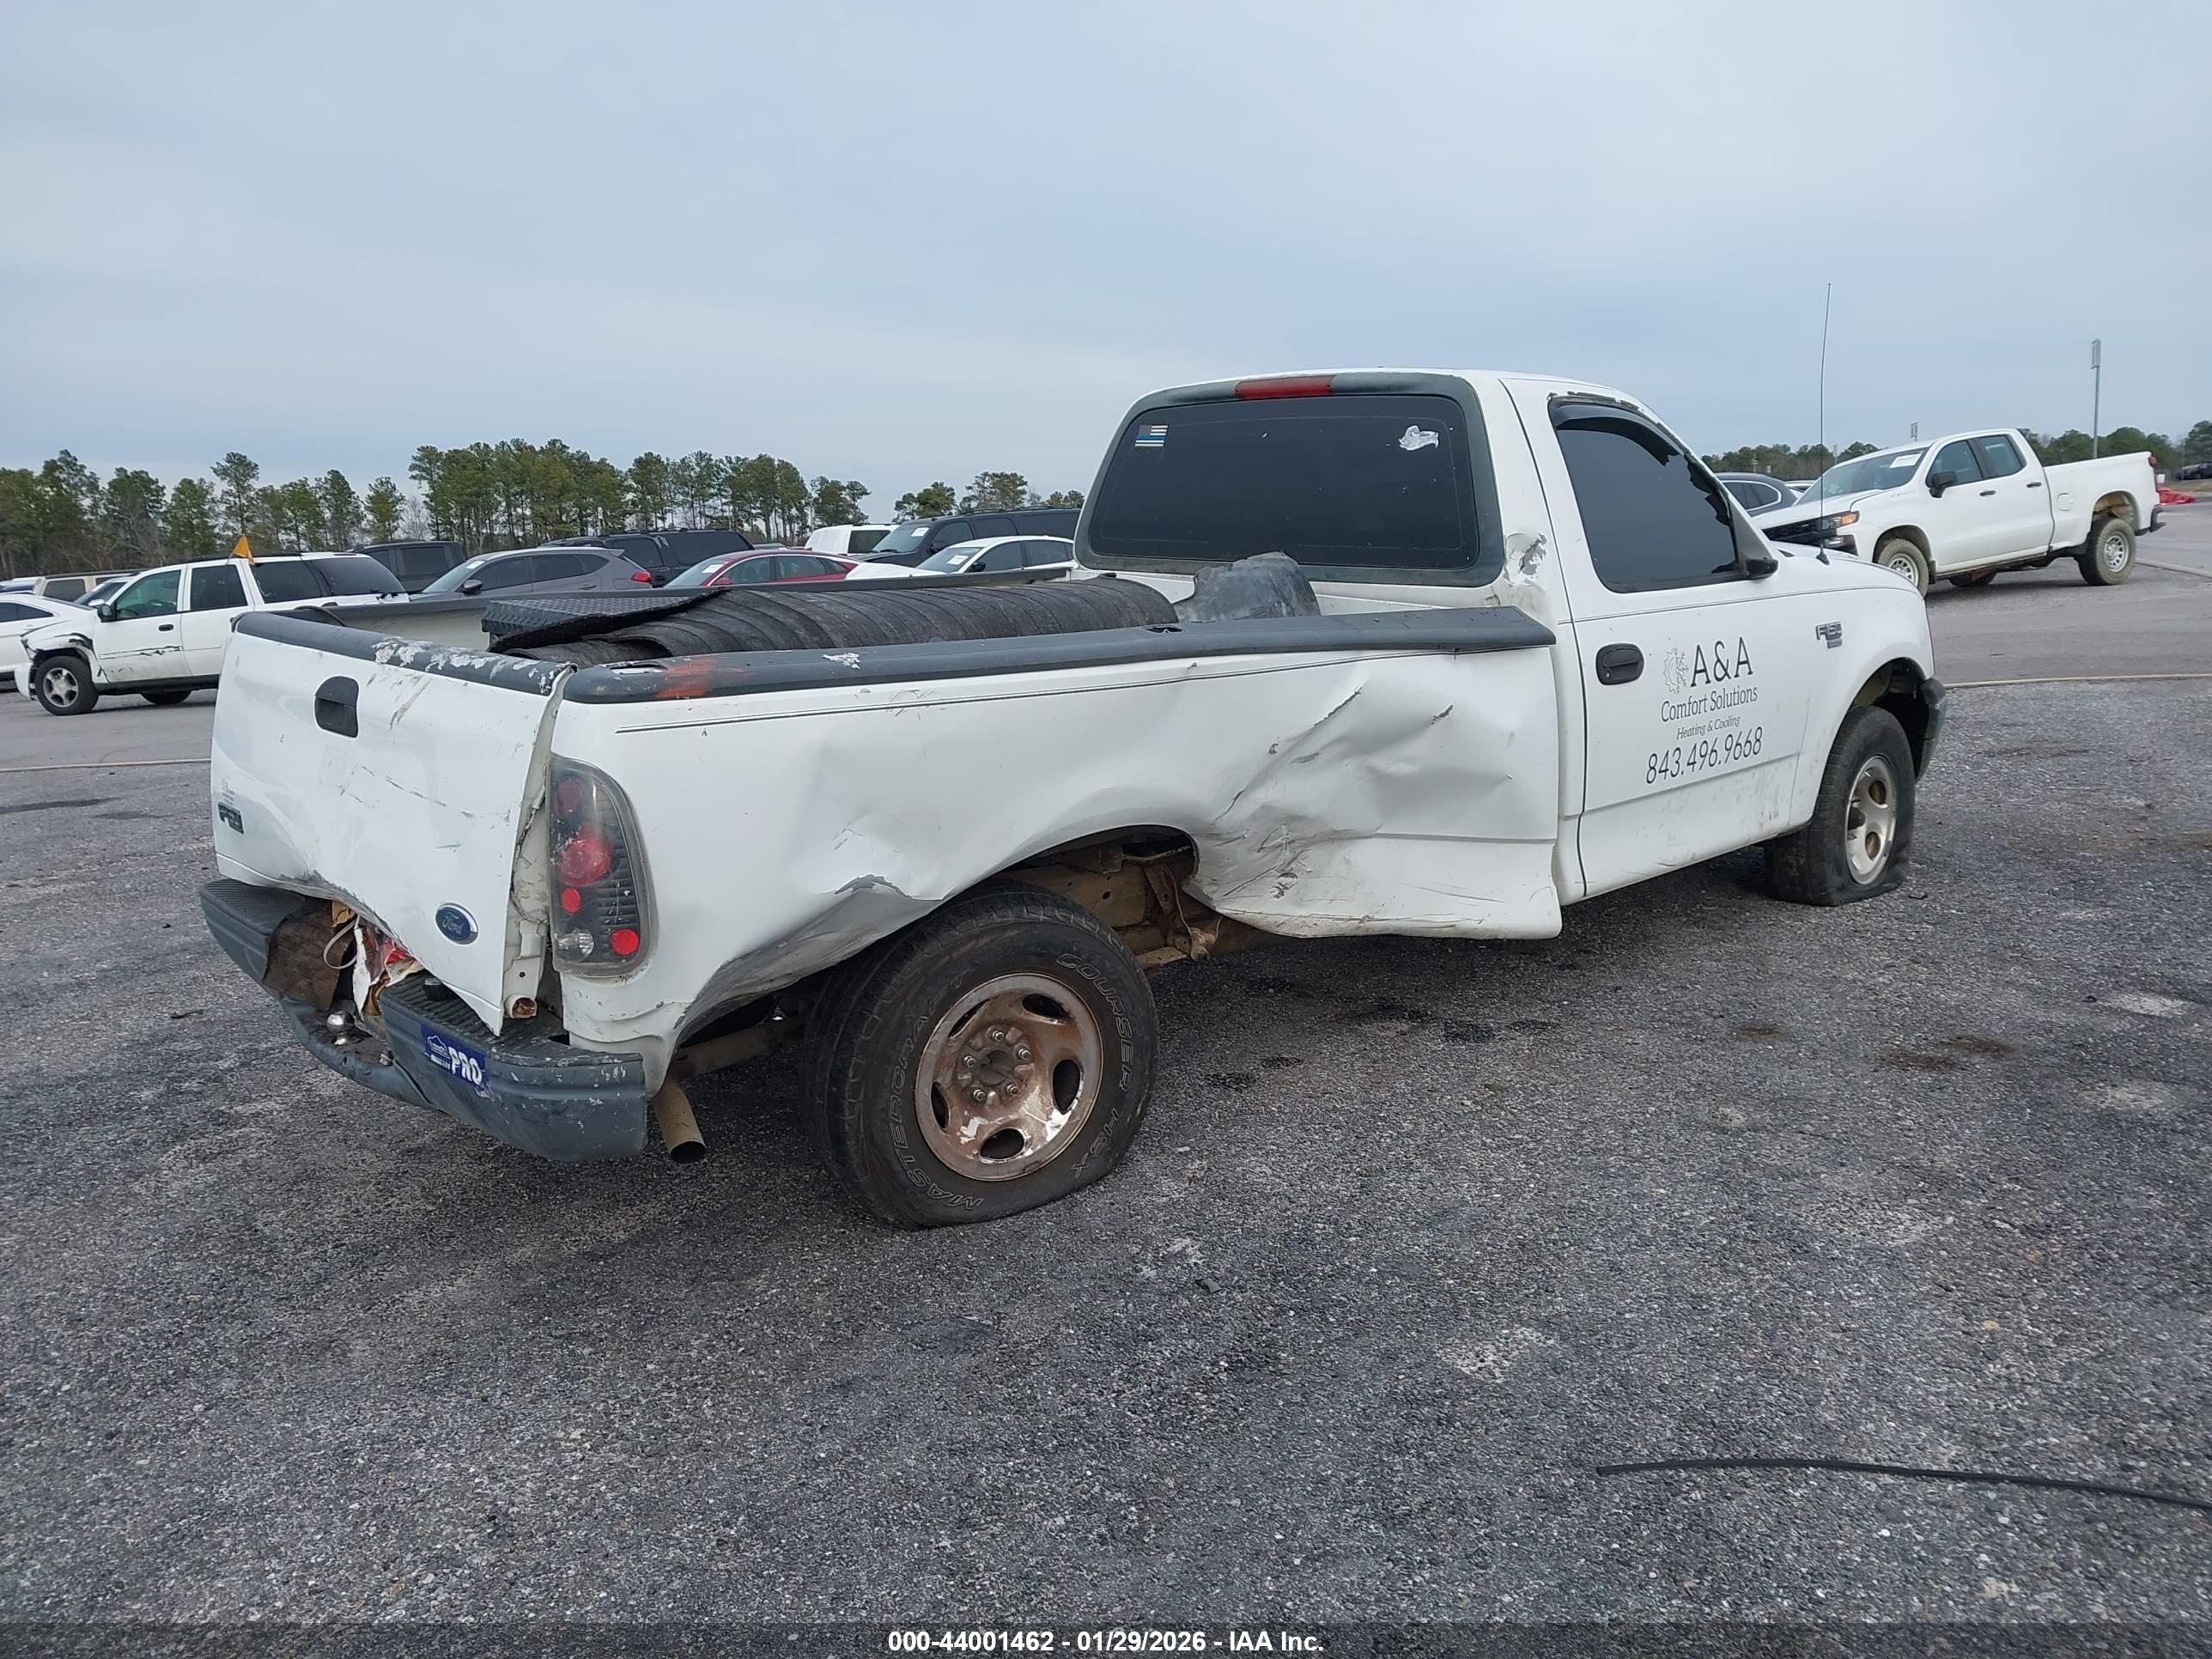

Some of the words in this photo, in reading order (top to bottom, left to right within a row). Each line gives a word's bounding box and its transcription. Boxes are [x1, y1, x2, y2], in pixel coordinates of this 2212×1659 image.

[1690, 636, 1753, 687] A&A
[1661, 693, 1707, 722] Comfort
[1710, 686, 1758, 712] Solutions
[1676, 723, 1706, 740] Heating
[1706, 722, 1713, 732] &
[1714, 714, 1741, 728] Cooling
[1646, 726, 1763, 785] 843.496.9668
[441, 911, 465, 935] Ford
[1056, 953, 1134, 1092] COURSER
[448, 1046, 483, 1085] PRO
